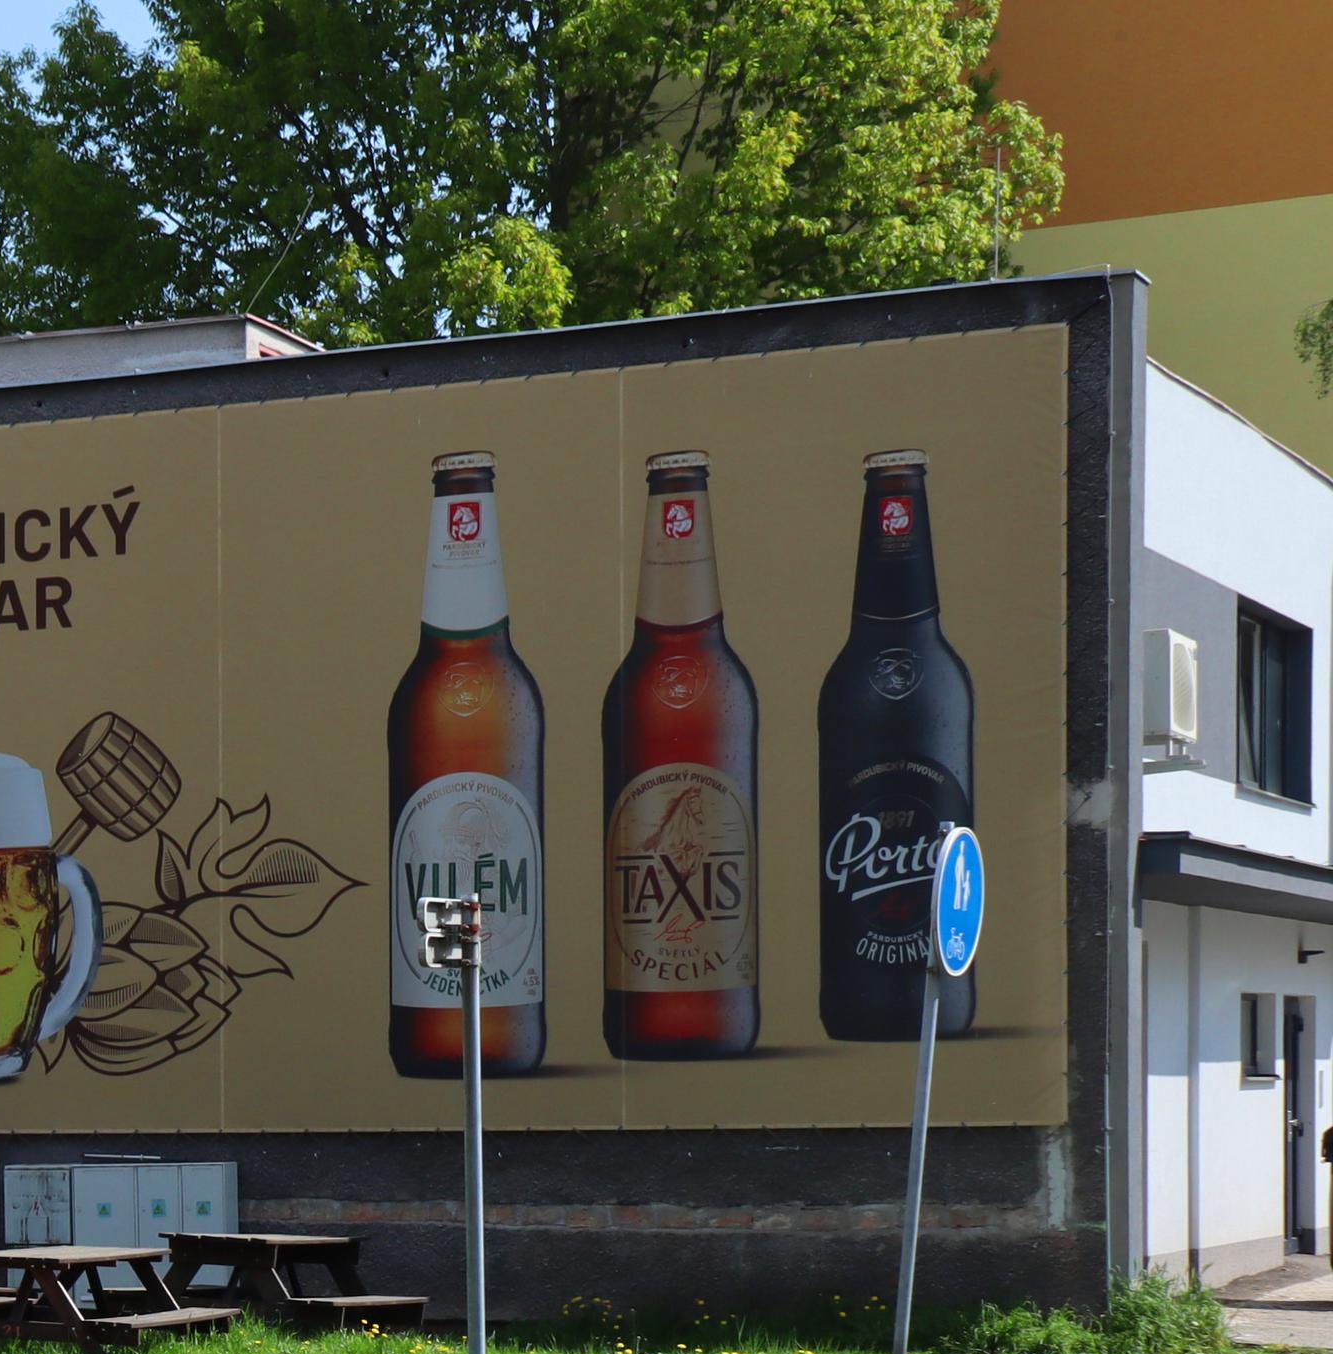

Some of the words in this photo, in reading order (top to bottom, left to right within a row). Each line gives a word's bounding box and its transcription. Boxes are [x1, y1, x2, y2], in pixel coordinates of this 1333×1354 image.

[631, 769, 689, 800] PARDUBICKÝ
[690, 773, 728, 796] PIVOVAR
[906, 762, 946, 785] PIVOVAR
[417, 780, 475, 811] PARDUBICKÝ
[476, 783, 515, 807] PIVOVAR
[614, 854, 742, 923] TAXIS
[631, 949, 731, 981] SPECIÁL
[423, 969, 511, 997] JEDENTKA
